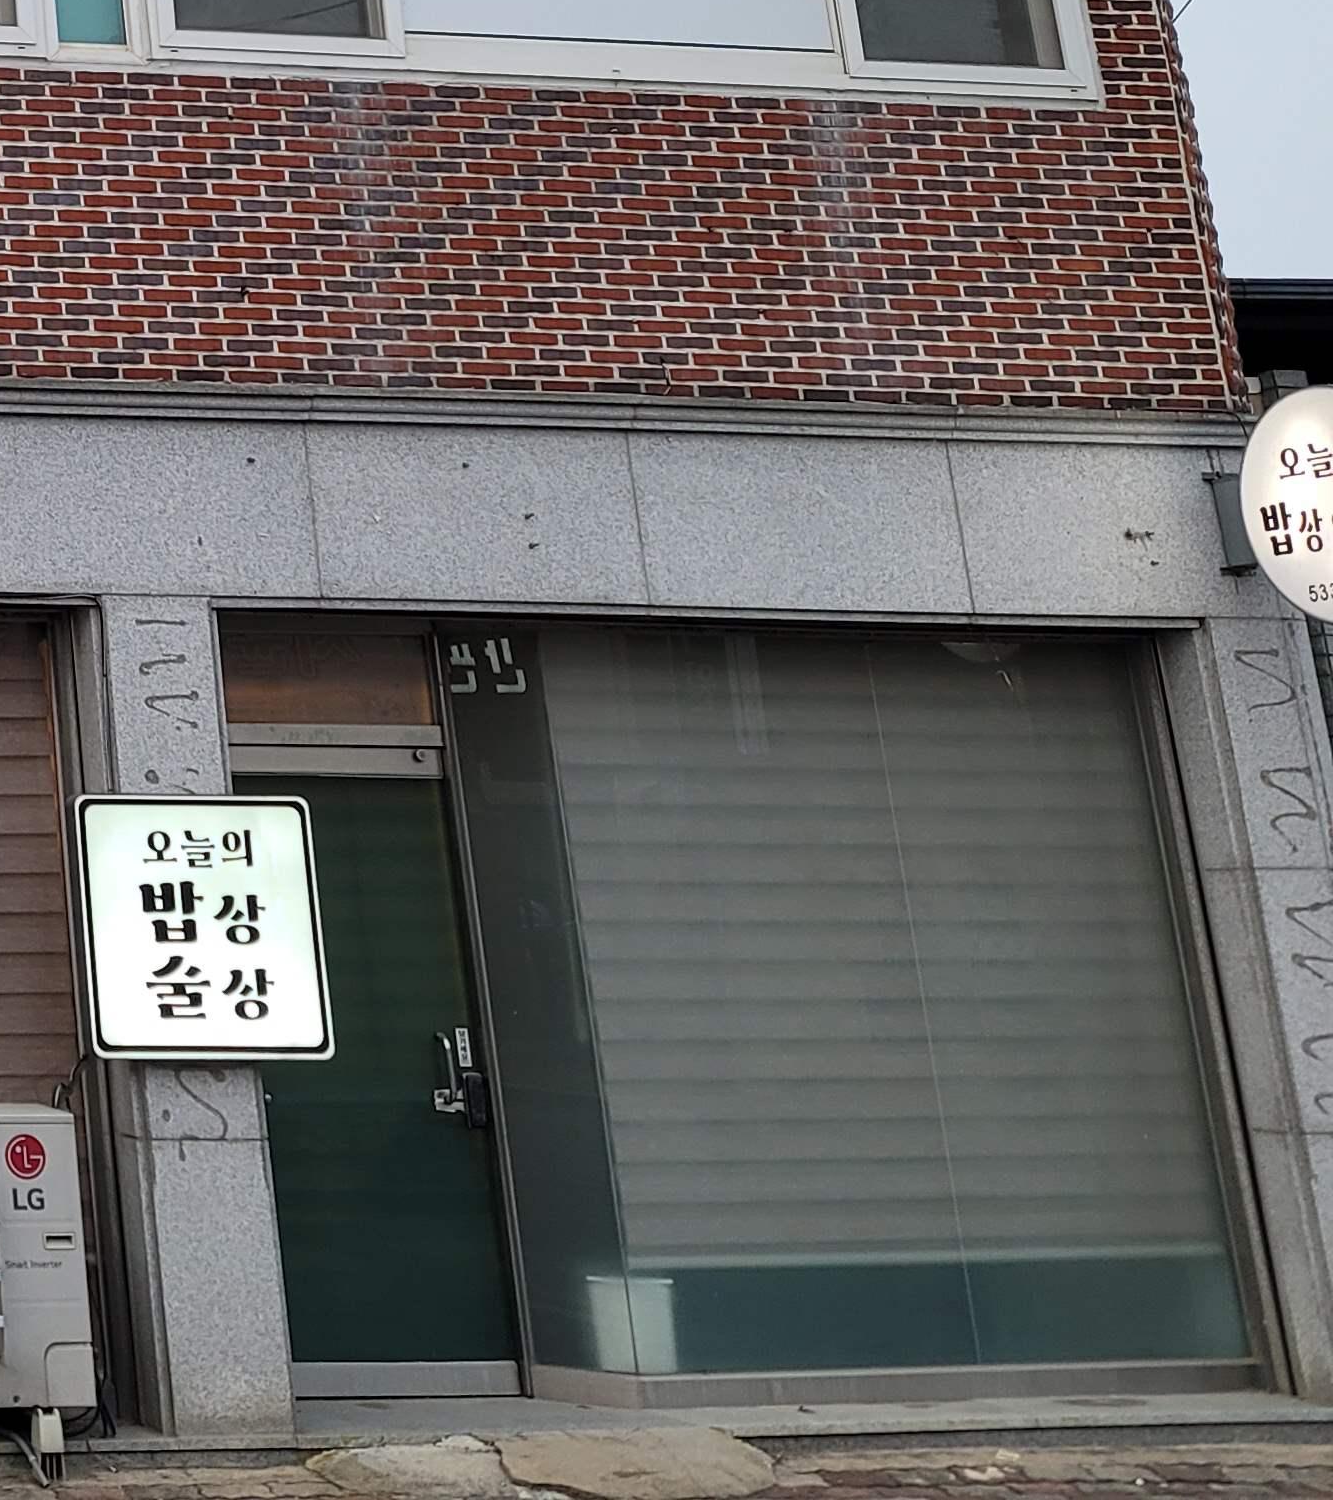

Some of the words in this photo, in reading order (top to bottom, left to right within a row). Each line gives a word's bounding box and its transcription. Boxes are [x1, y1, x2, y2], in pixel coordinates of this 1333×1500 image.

[1259, 501, 1323, 556] 밥상
[142, 829, 254, 869] 오늘의
[138, 881, 266, 946] 밥상
[145, 955, 275, 1021] 술상
[12, 1187, 46, 1211] LG
